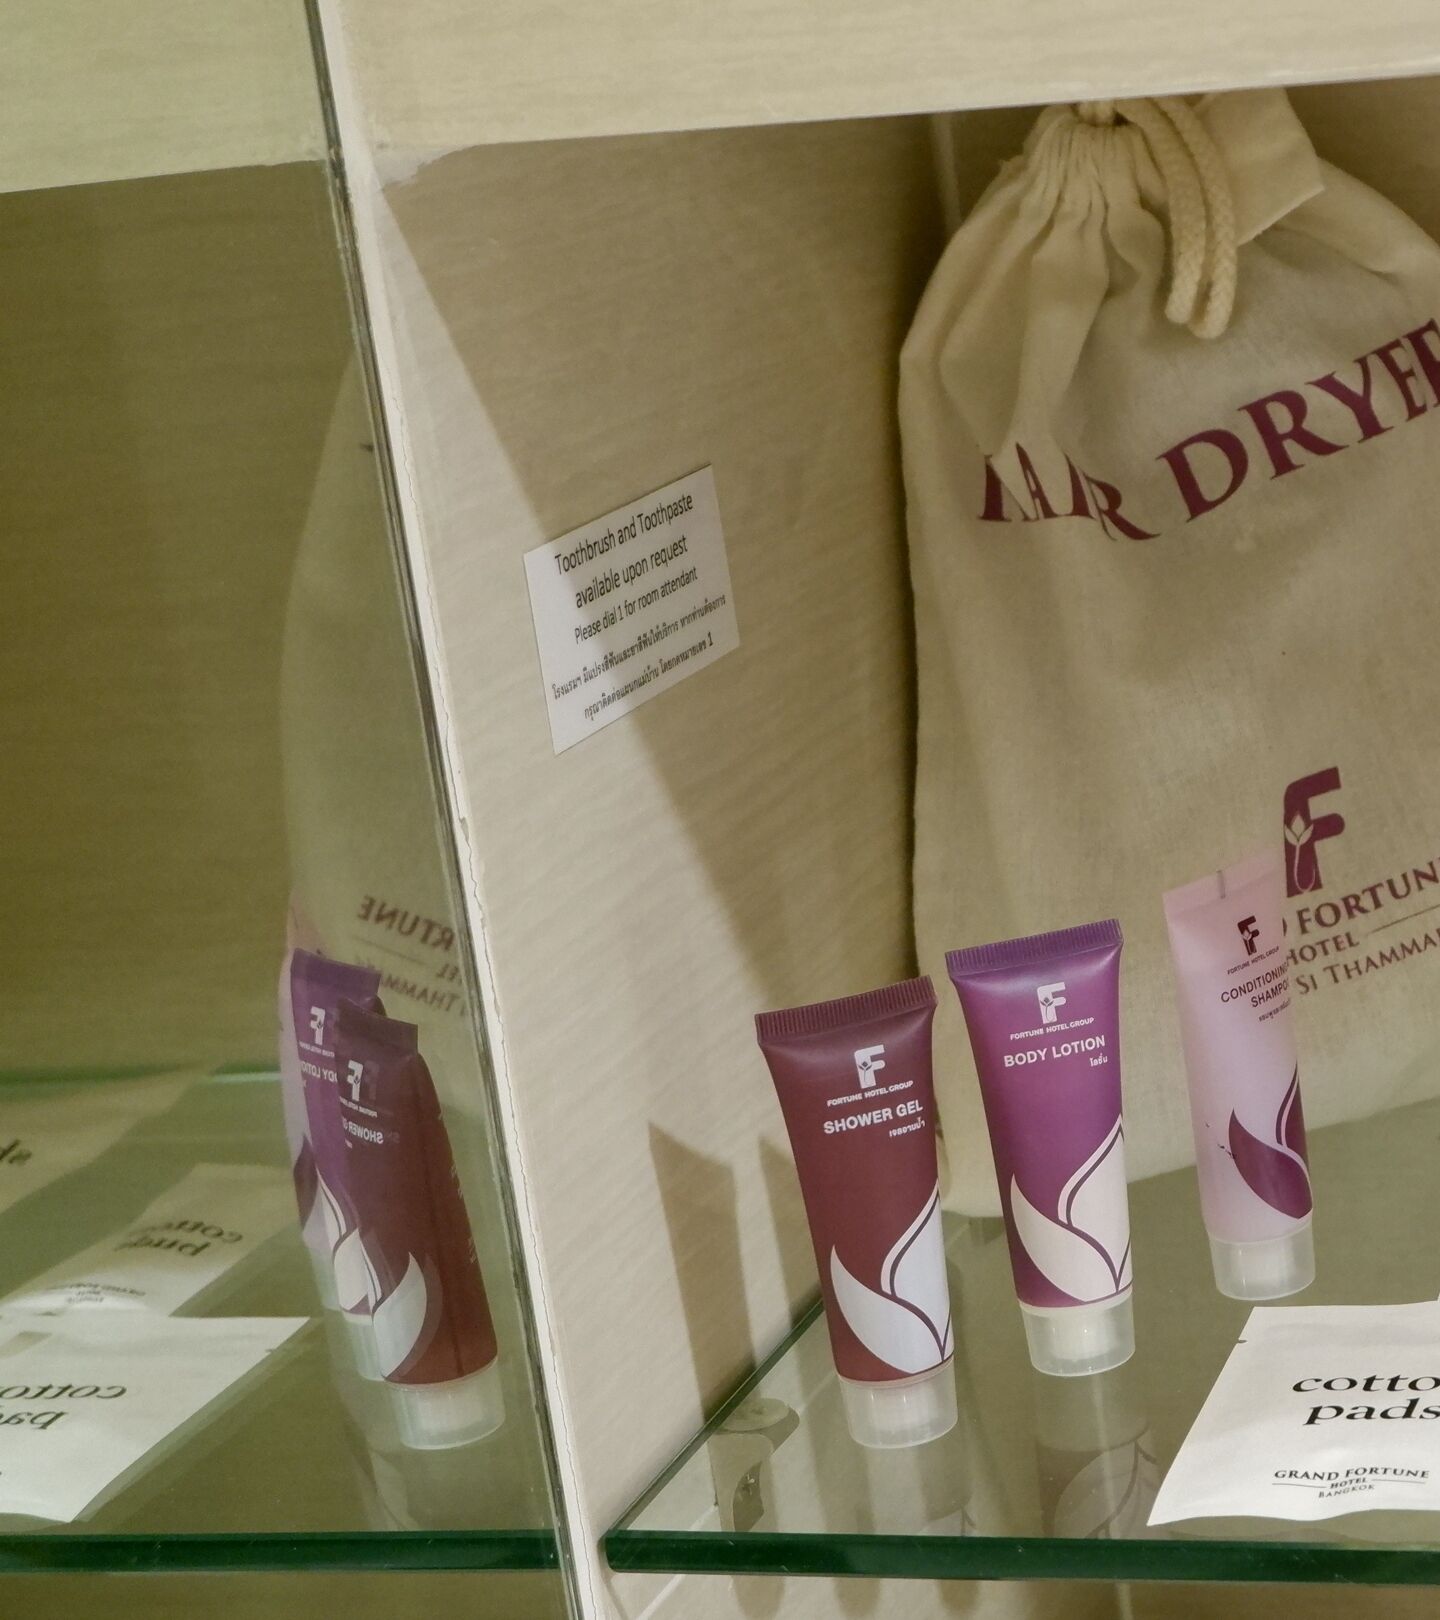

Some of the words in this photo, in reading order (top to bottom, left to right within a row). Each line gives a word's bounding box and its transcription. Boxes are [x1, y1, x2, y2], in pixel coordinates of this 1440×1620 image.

[555, 529, 616, 574] Toothbrush
[618, 516, 637, 544] and
[637, 494, 693, 534] Toothpaste
[576, 568, 620, 608] available
[622, 558, 648, 586] upon
[650, 535, 688, 568] request
[574, 618, 601, 644] Please
[603, 611, 617, 629] dial
[618, 606, 624, 620] 1
[624, 600, 636, 616] for
[638, 590, 660, 608] room
[661, 567, 698, 598] attendant
[708, 631, 714, 646] 1
[1287, 931, 1360, 966] HOTEL
[1250, 978, 1289, 1008] SHAMPO
[1010, 1028, 1044, 1040] FORTUNE
[1046, 1024, 1069, 1033] HOTEL
[1070, 1017, 1094, 1028] GROUP
[1004, 1048, 1048, 1068] BODY
[1052, 1035, 1106, 1058] LOTION
[827, 1093, 862, 1107] FORTUNE
[864, 1088, 888, 1098] HOTEL
[888, 1080, 914, 1092] GROUP
[824, 1108, 893, 1134] SHOWER
[896, 1100, 924, 1117] GEL
[1274, 1470, 1340, 1480] GRAND
[1345, 1467, 1430, 1478] FORTUNE
[1330, 1478, 1367, 1489] HOTEL
[1318, 1484, 1375, 1498] BANGKOK
